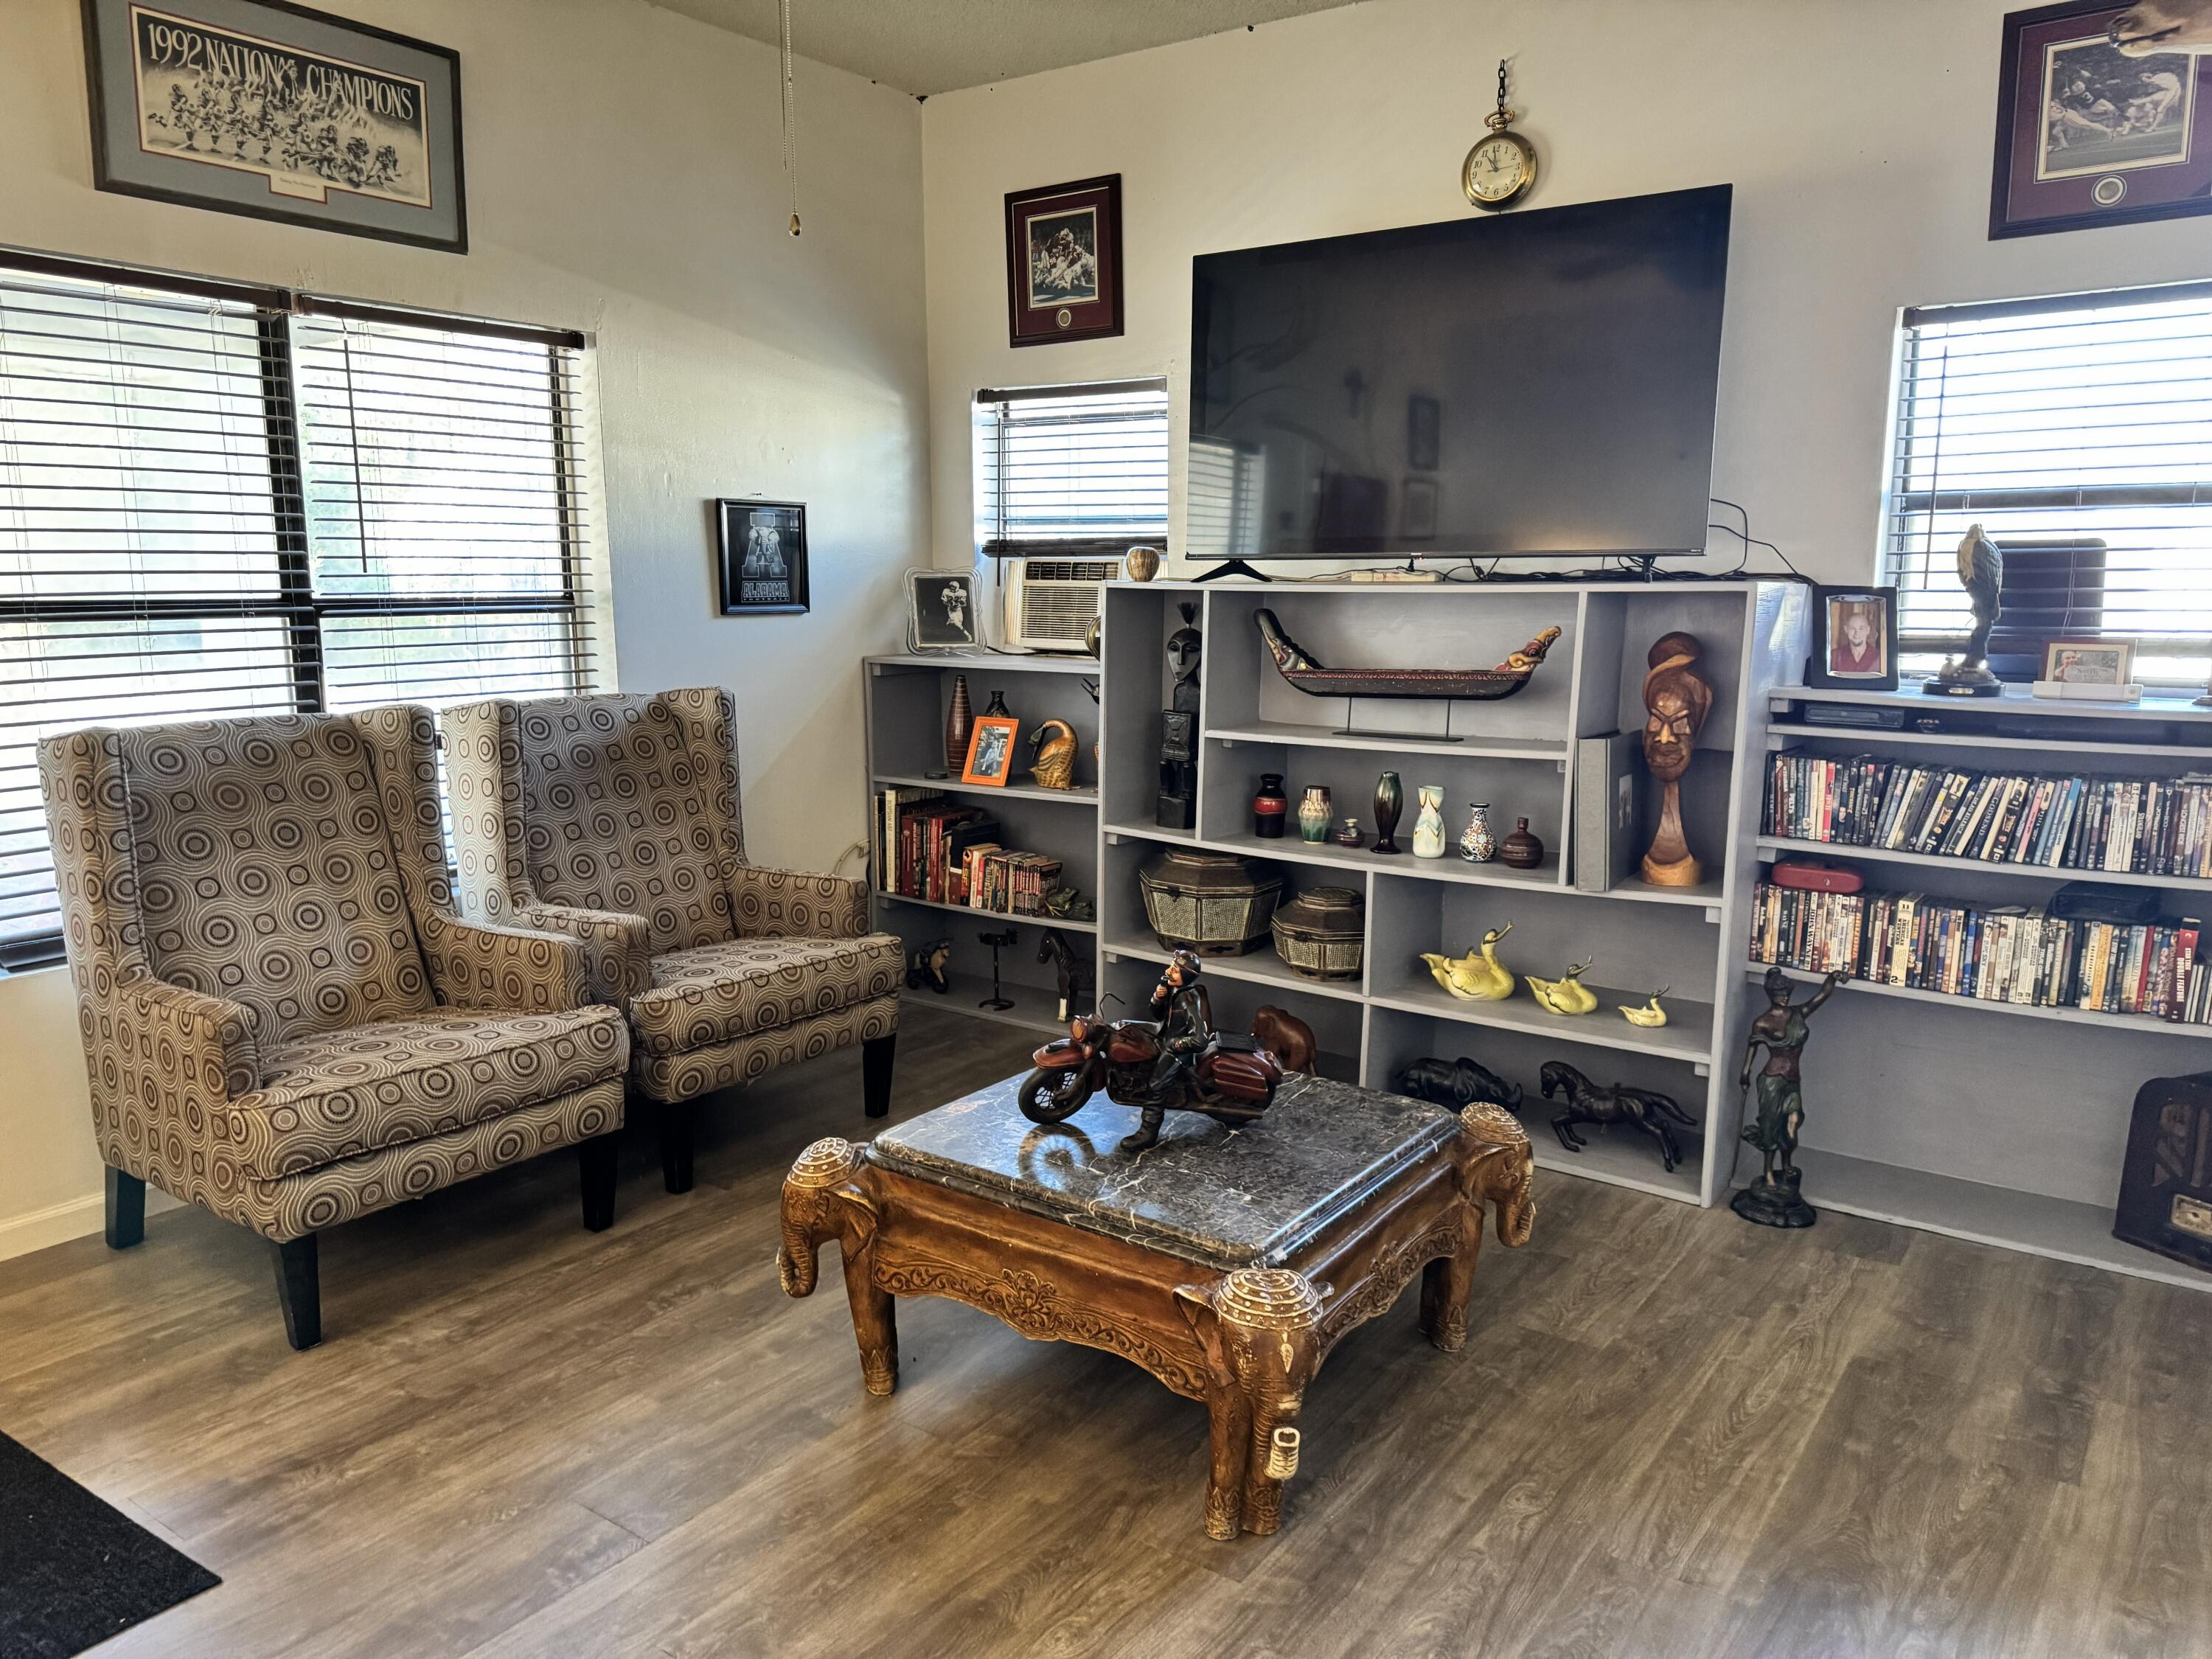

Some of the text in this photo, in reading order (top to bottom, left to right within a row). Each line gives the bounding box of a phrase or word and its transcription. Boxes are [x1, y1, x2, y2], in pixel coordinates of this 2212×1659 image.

[147, 23, 414, 120] 1992 NATIONA CHAMPIONS
[1511, 152, 1517, 160] 2
[1474, 160, 1482, 168] 10
[1515, 162, 1520, 170] 3
[1472, 171, 1477, 179] 9
[1484, 187, 1489, 195] 7
[1494, 188, 1499, 196] 6
[1504, 183, 1509, 192] 5
[743, 582, 789, 597] ALABAMA
[1978, 797, 1998, 836] GODSEND
[2179, 809, 2188, 833] LONGEST
[1805, 908, 1816, 959] JOHN WAYNE
[1851, 912, 1862, 959] ARIZONA
[1890, 975, 1899, 984] 2
[2176, 957, 2185, 1003] DOUBLE FEATURE
